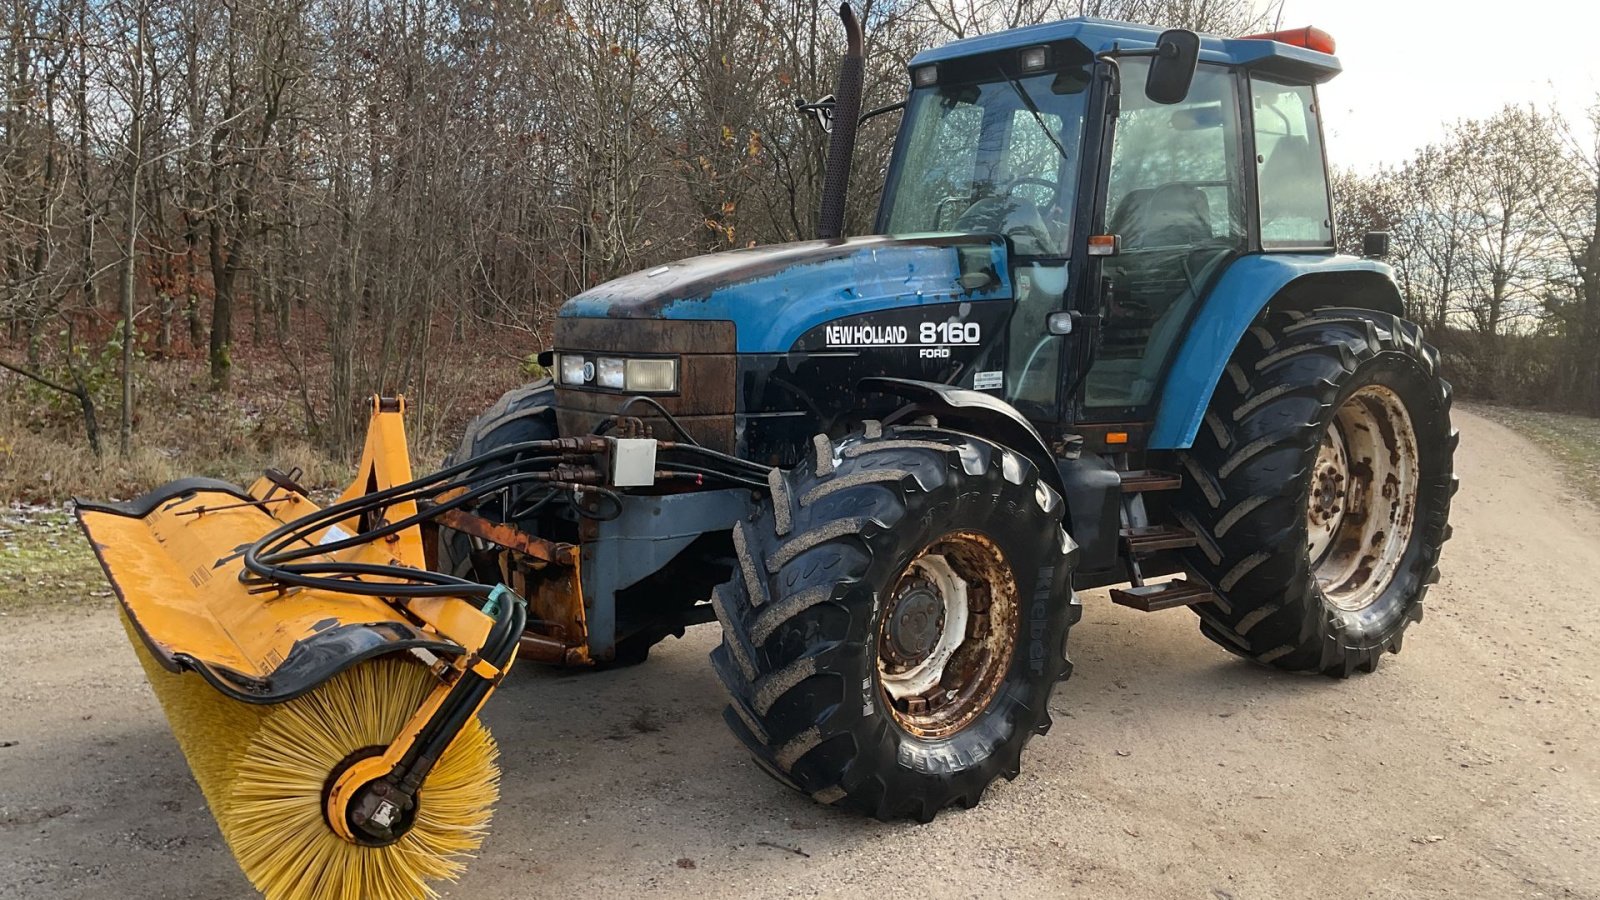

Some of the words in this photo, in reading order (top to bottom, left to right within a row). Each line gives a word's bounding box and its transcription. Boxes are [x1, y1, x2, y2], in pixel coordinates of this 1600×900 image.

[826, 326, 852, 344] NEW
[854, 326, 907, 344] HOLLAND
[919, 322, 980, 343] 8160
[919, 349, 950, 358] FORD
